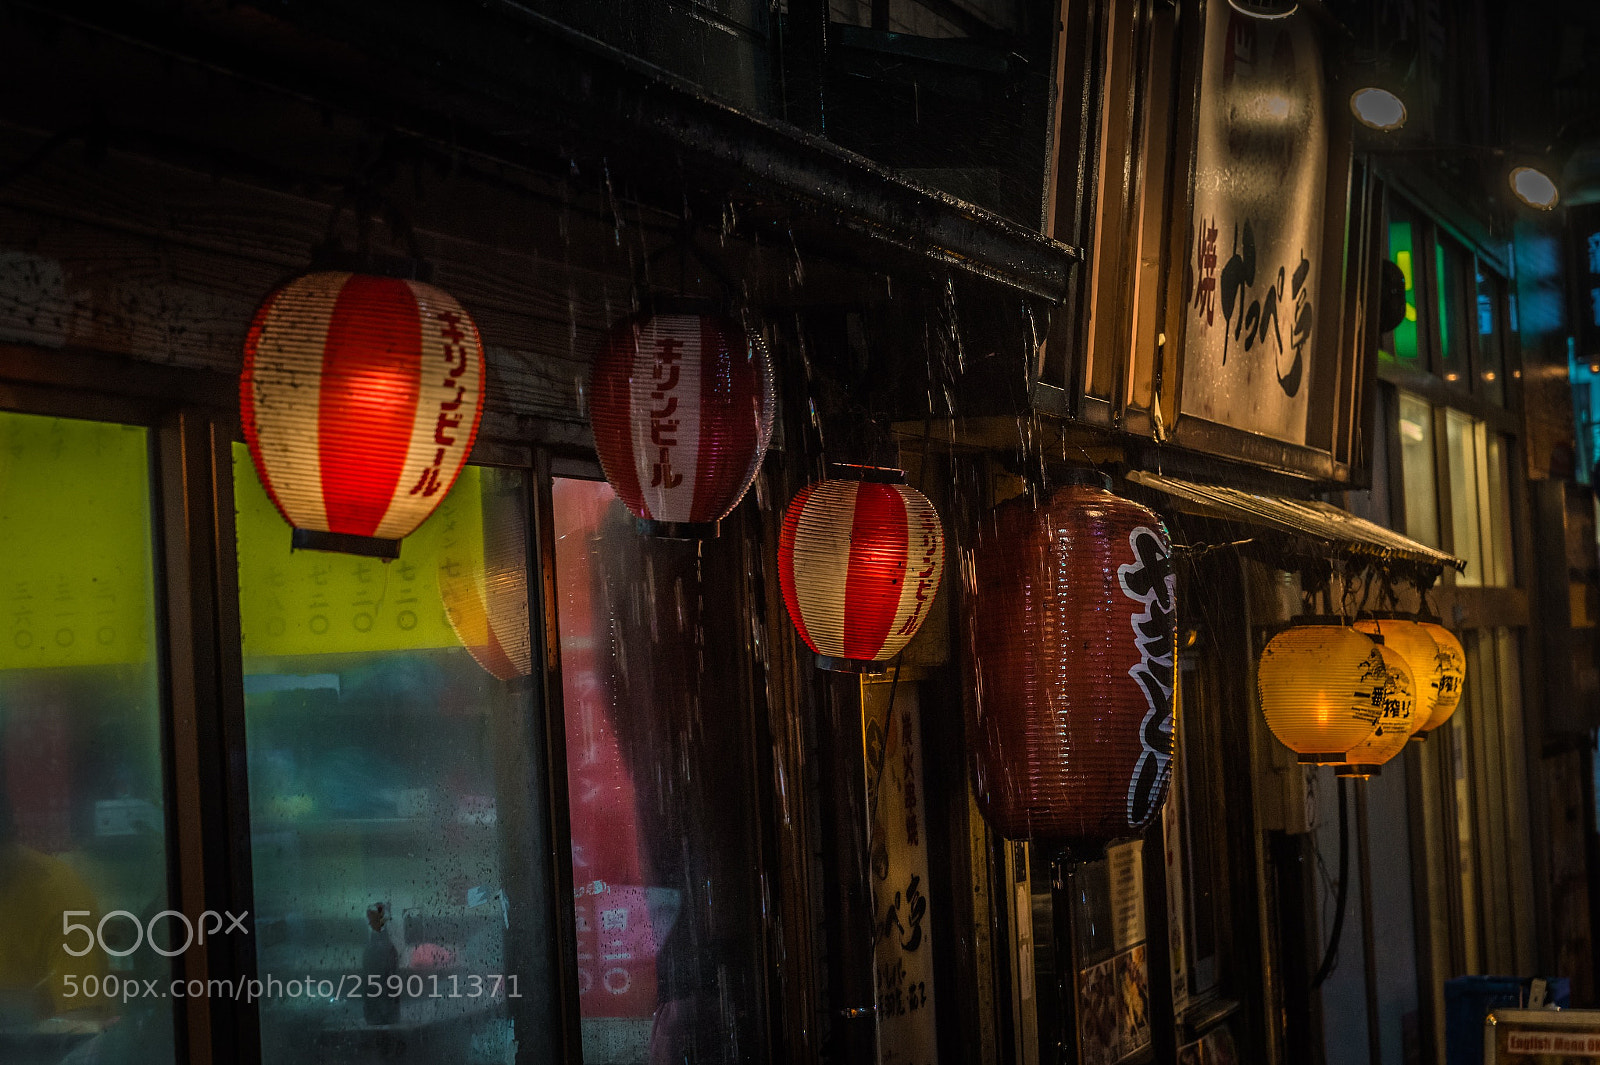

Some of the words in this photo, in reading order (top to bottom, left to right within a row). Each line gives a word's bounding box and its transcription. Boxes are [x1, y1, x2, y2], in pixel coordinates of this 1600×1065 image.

[410, 310, 467, 497] キリンビール
[650, 337, 685, 490] キリンビール
[896, 510, 938, 636] キリンビール
[1510, 1035, 1551, 1051] English
[1554, 1037, 1585, 1051] Menu
